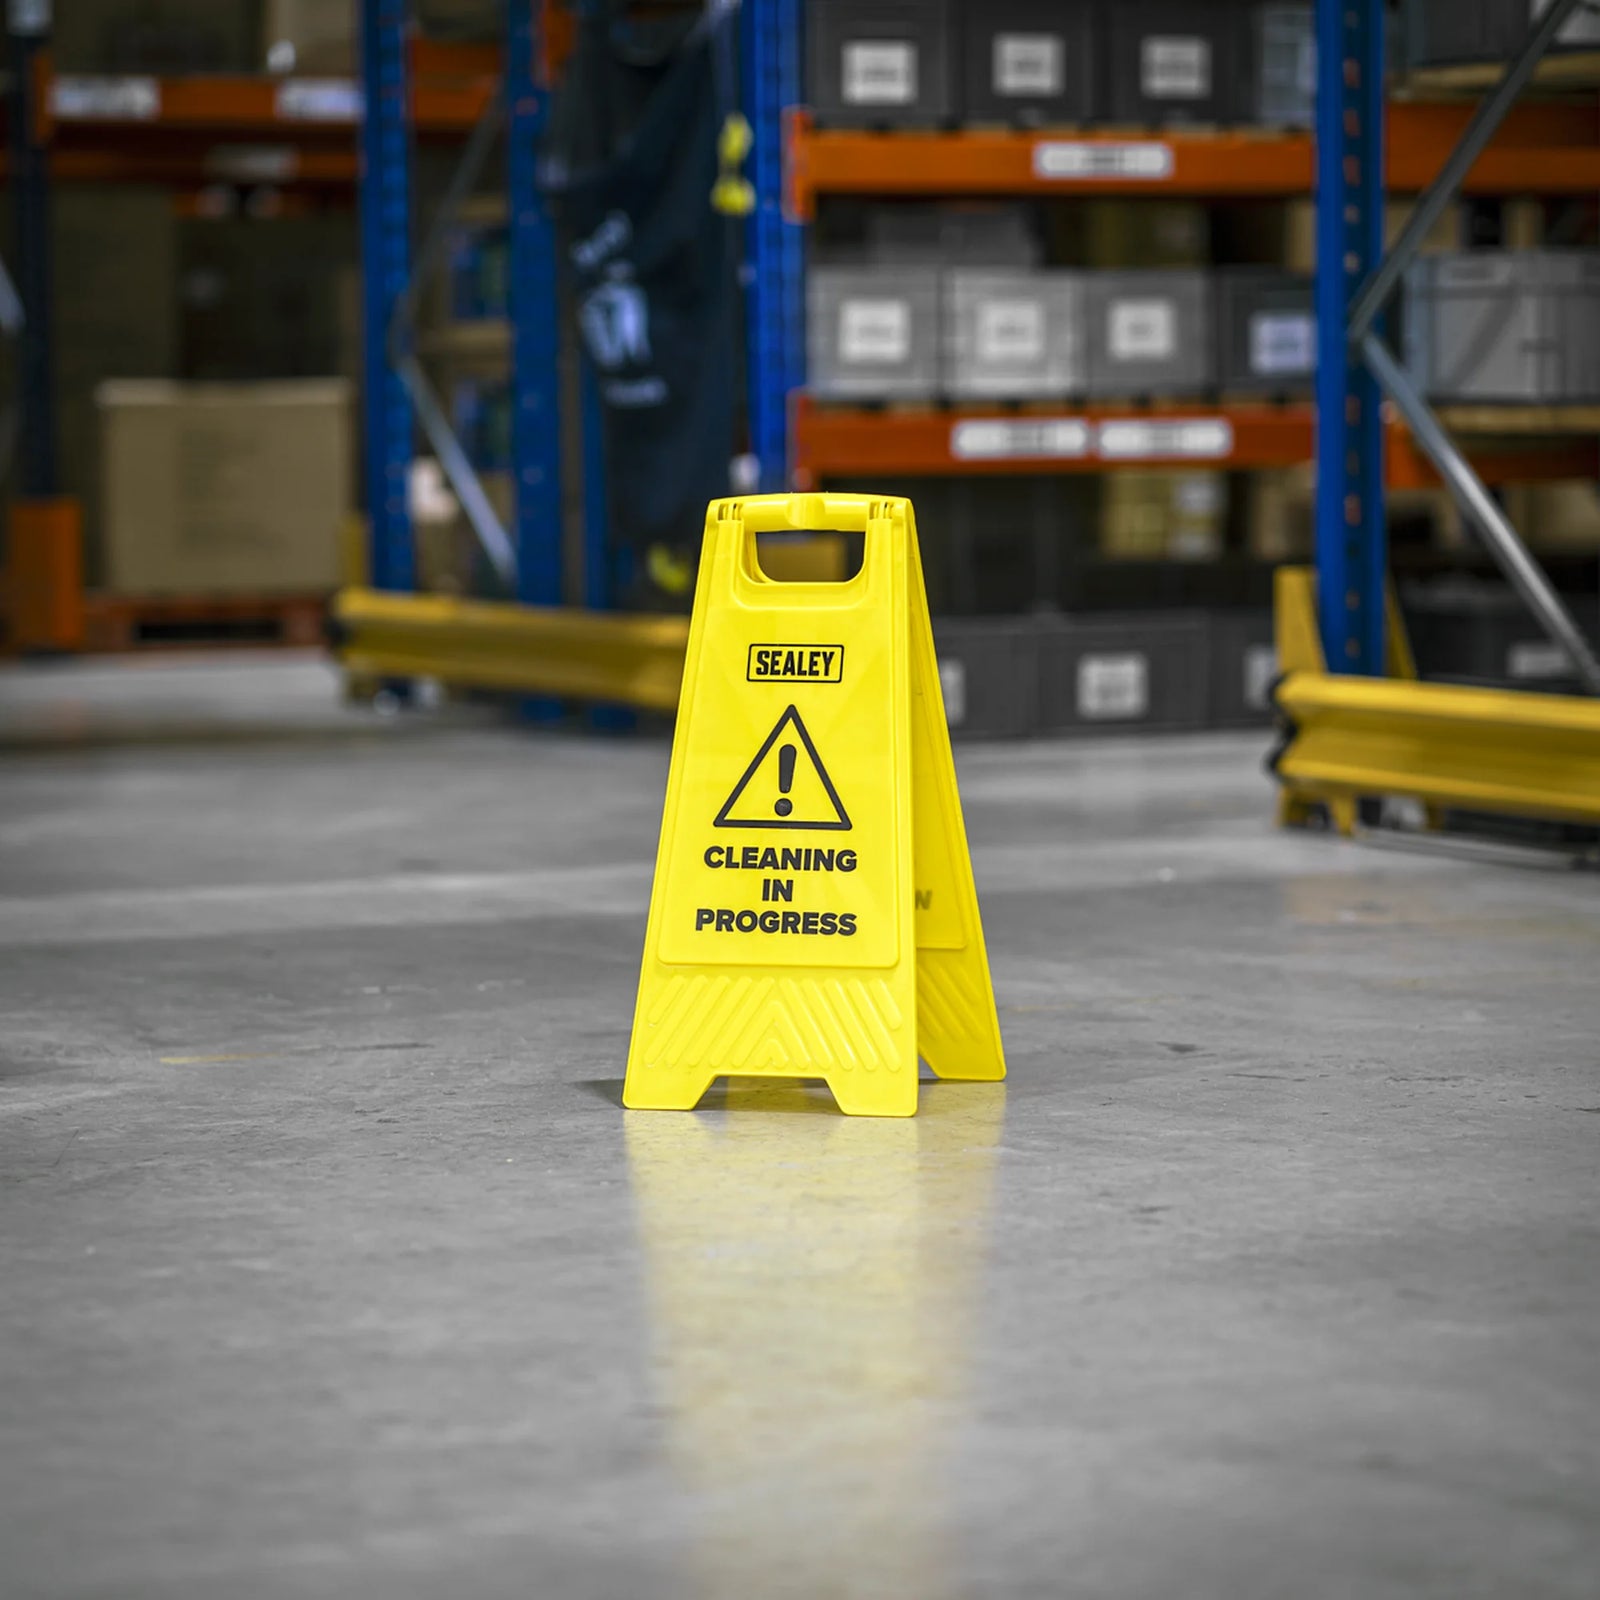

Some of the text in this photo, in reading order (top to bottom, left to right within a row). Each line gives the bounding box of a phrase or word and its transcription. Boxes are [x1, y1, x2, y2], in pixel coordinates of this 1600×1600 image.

[755, 650, 837, 677] SEALEY
[704, 846, 857, 872] CLEANING
[762, 879, 793, 902] IN
[695, 908, 857, 936] PROGRESS
